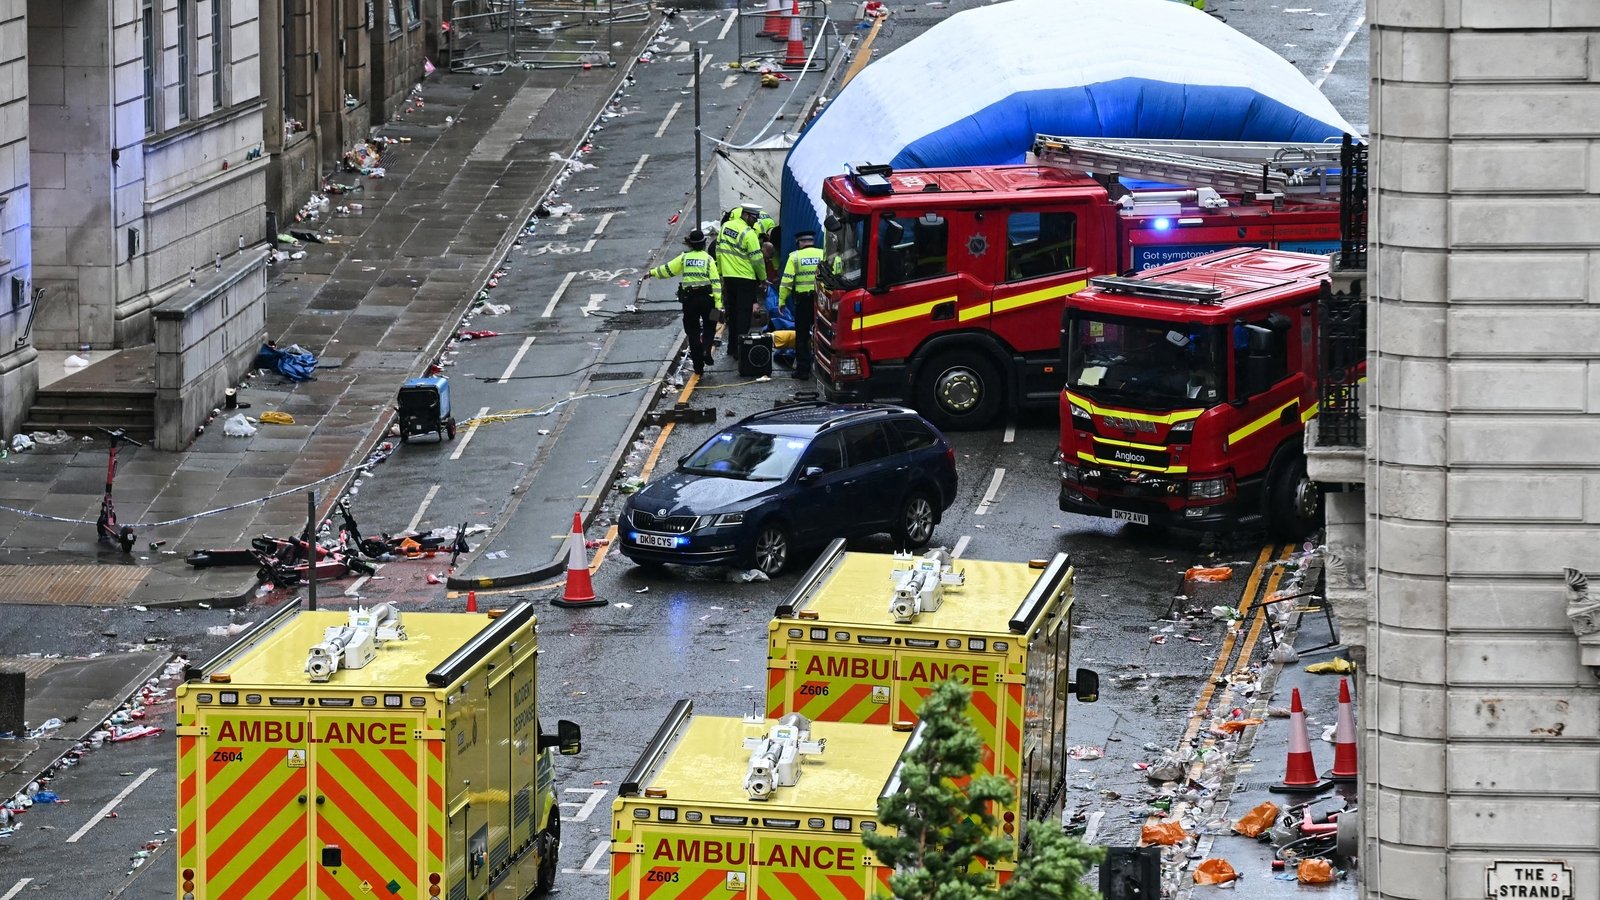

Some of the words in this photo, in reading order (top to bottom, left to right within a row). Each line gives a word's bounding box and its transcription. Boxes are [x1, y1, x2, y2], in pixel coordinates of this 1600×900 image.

[723, 227, 739, 240] POLICE
[1143, 251, 1160, 260] Got
[1297, 247, 1318, 256] Play
[686, 259, 706, 267] POLICE
[801, 257, 821, 266] POLICE
[1103, 417, 1158, 433] SCANIA
[1115, 450, 1145, 462] Angloco
[1114, 510, 1132, 520] DK72
[1133, 513, 1146, 523] AVU
[640, 536, 656, 545] DK18
[657, 538, 671, 546] CYS
[805, 655, 989, 686] AMBULANCE
[799, 684, 830, 697] Z606
[218, 720, 407, 744] AMBULANCE
[212, 751, 243, 763] Z604
[653, 838, 855, 870] AMBULANCE
[646, 870, 680, 884] Z603
[1514, 868, 1544, 881] THE
[1551, 873, 1558, 882] 2
[1499, 885, 1560, 898] STRAND
